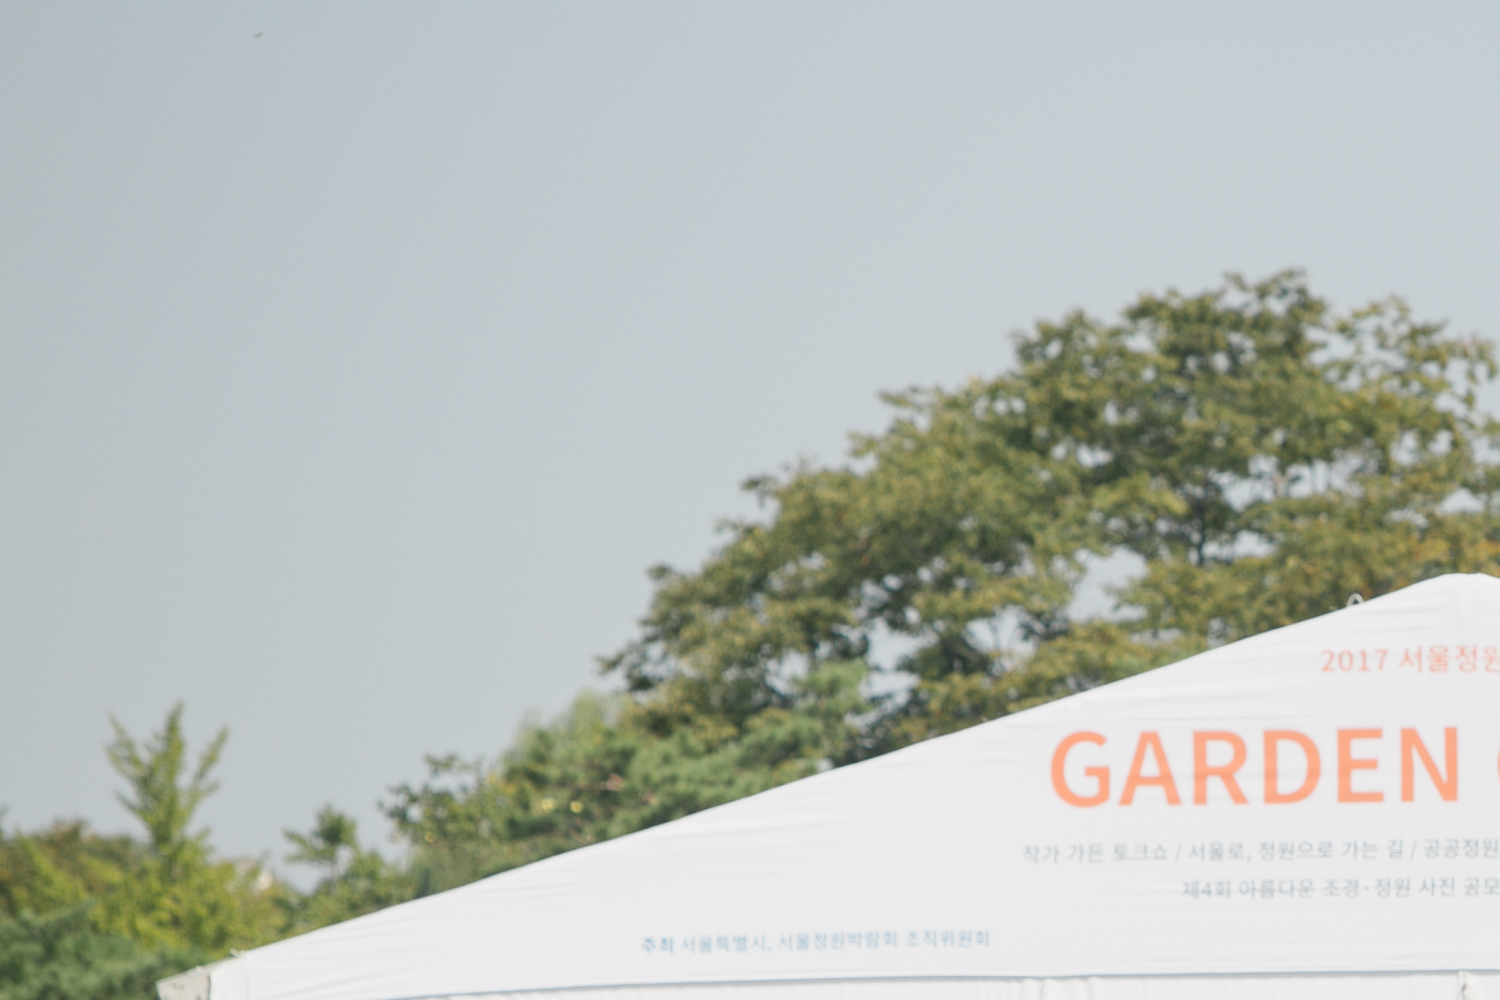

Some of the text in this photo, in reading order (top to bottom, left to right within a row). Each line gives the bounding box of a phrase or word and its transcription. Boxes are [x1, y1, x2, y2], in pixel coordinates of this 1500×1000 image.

[1322, 650, 1390, 674] 2017
[1051, 727, 1459, 809] GARDEN
[1024, 845, 1060, 865] 작가
[1068, 844, 1104, 864] 가든
[1114, 844, 1169, 863] 토크쇼
[1188, 842, 1253, 864] 서울로,
[1259, 841, 1335, 862] 정원으로
[1342, 841, 1379, 861] 가는
[1387, 840, 1404, 860] 길
[1182, 880, 1234, 901] 제4회
[1239, 879, 1318, 901] 아름다운
[1419, 878, 1457, 899] 사진
[642, 936, 677, 956] 주최
[778, 930, 900, 952] 서울정원박람회
[905, 930, 992, 950] 조직위원회
